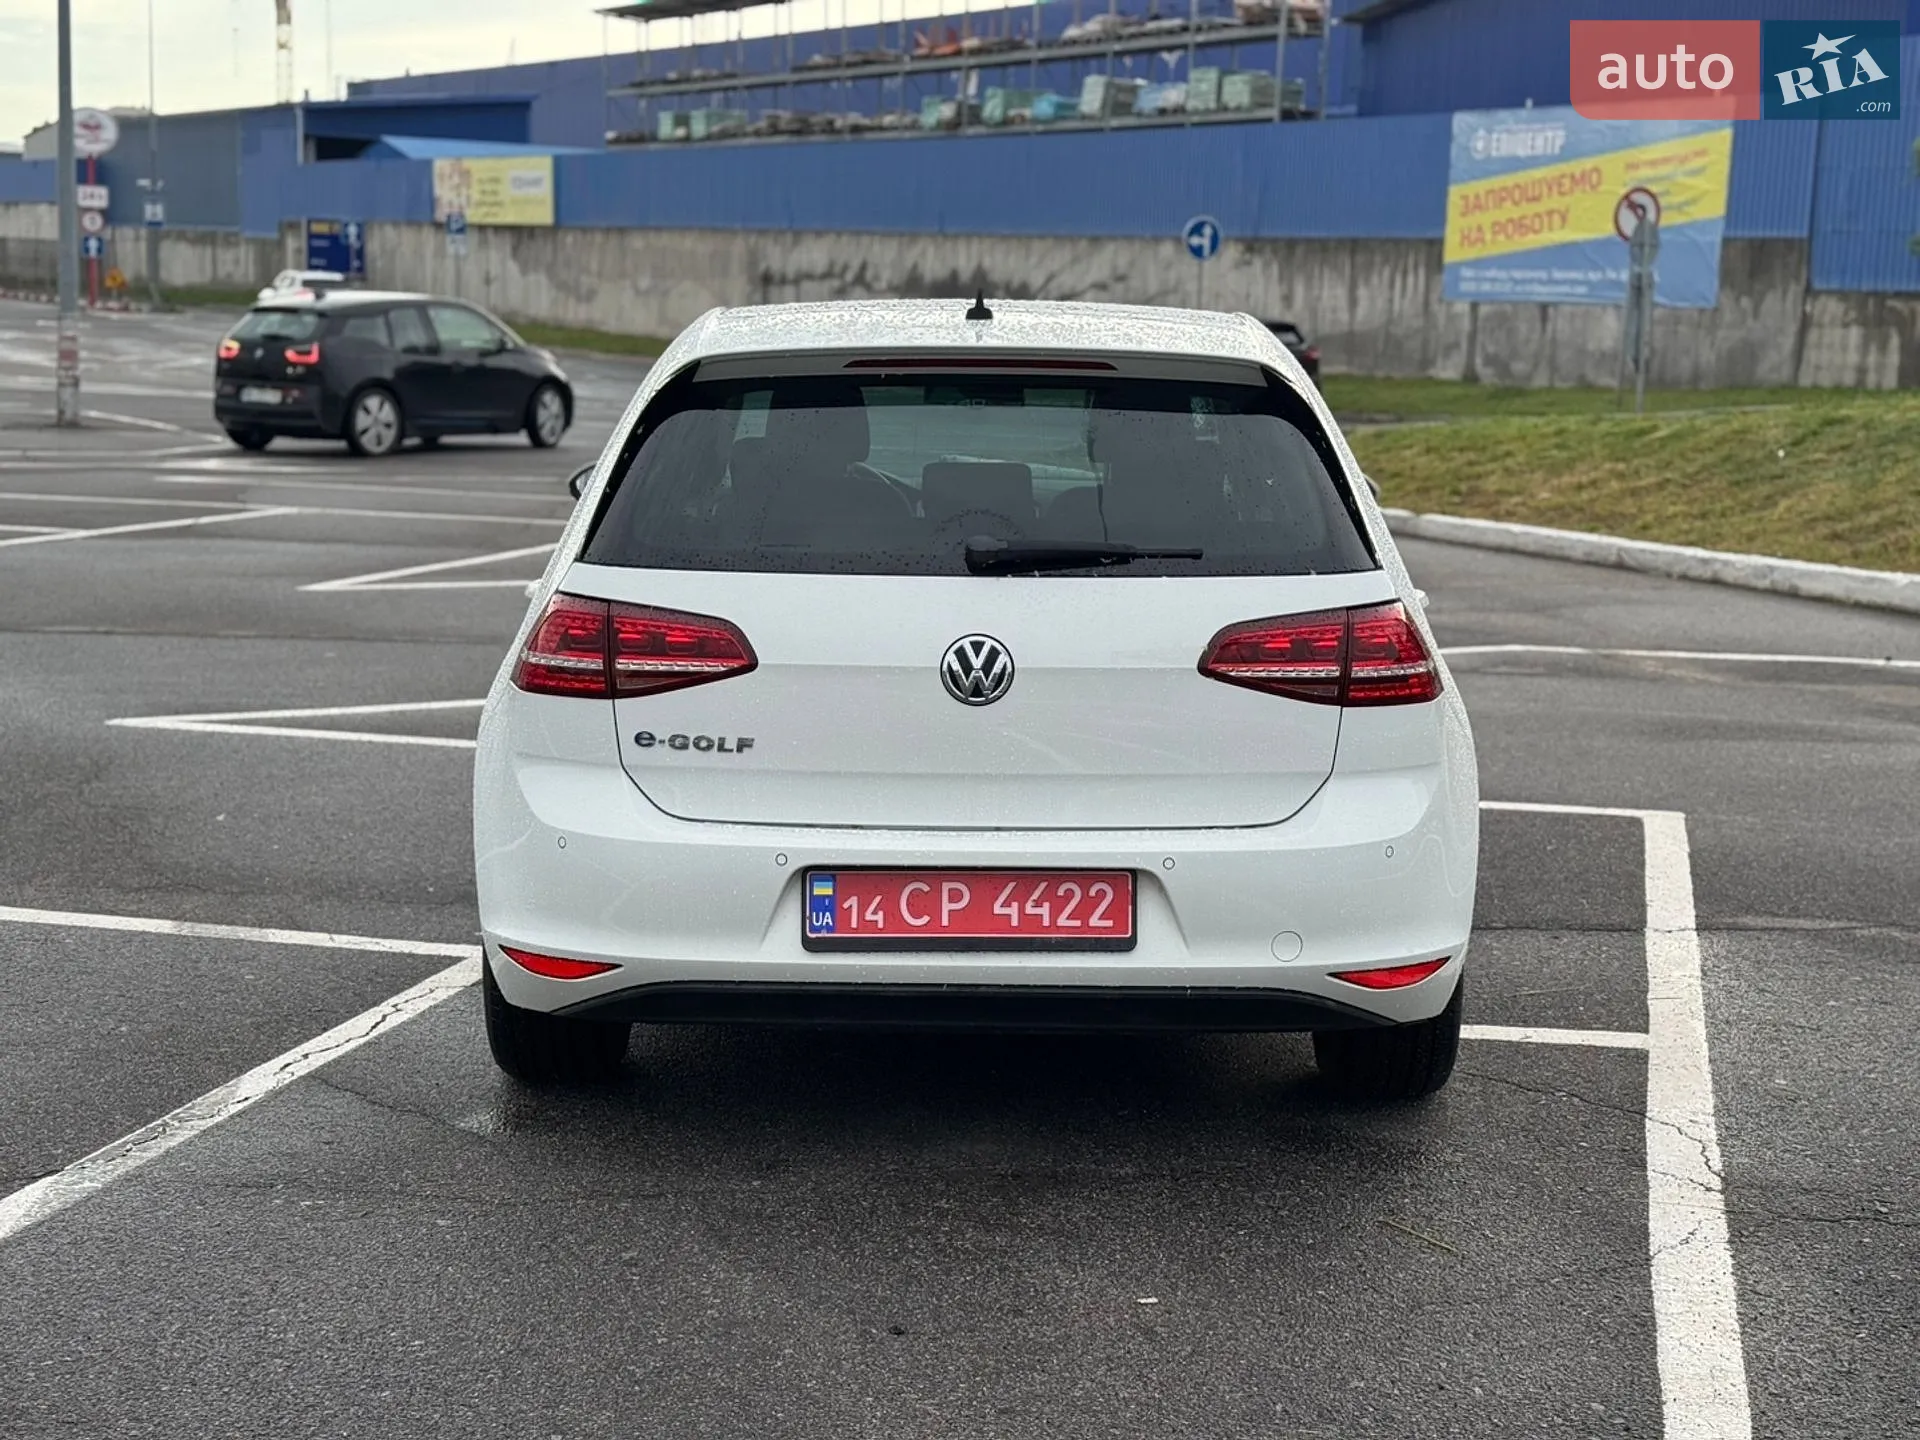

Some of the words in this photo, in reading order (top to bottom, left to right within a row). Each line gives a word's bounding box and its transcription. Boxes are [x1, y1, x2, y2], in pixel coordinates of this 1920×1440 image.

[1459, 225, 1486, 248] НА
[1490, 206, 1570, 244] РОБОТУ
[634, 730, 756, 754] e-GOLF
[812, 910, 833, 927] UA
[842, 895, 884, 929] 14
[899, 881, 971, 928] CP
[993, 881, 1114, 928] 4422
